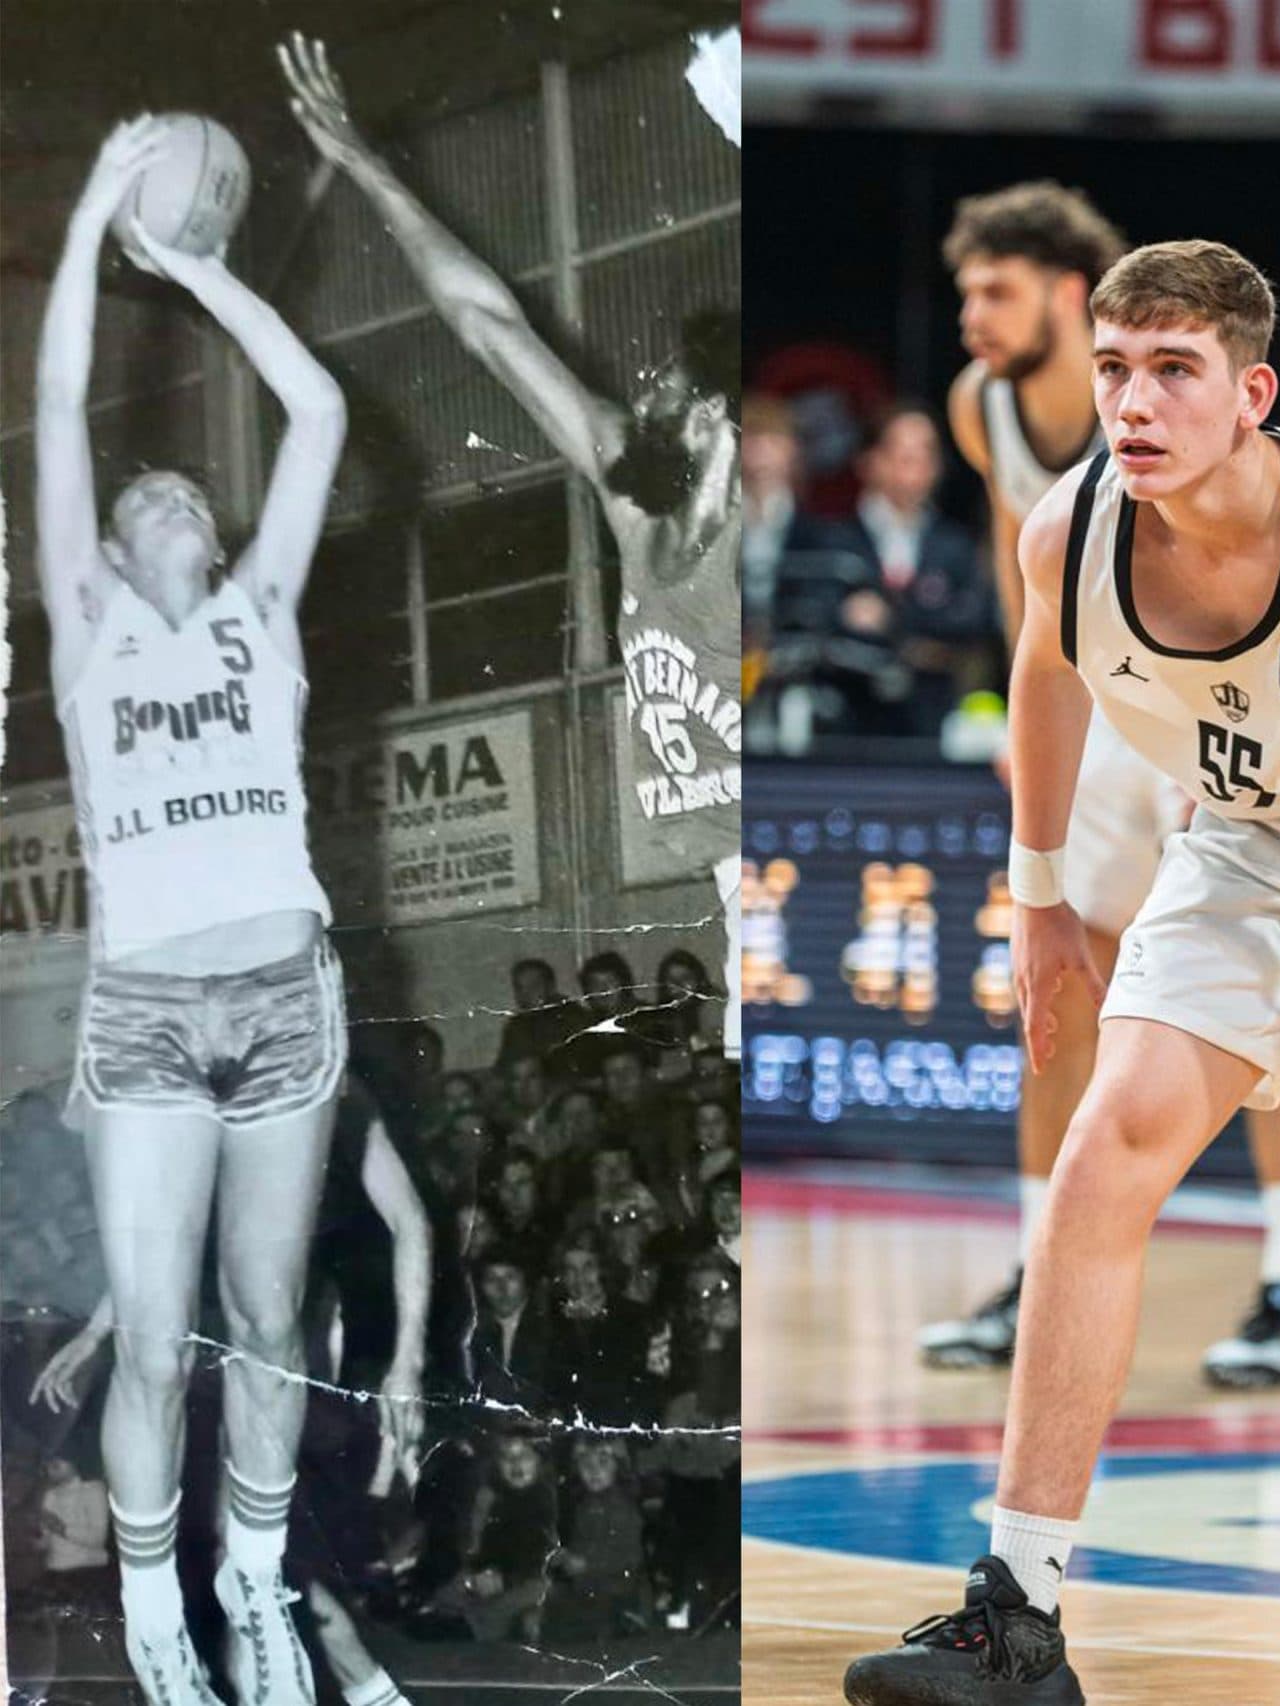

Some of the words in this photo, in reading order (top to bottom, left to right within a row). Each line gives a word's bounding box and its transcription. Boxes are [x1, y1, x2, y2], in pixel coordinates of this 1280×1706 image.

[209, 617, 253, 674] 5
[641, 702, 698, 774] 15
[1198, 719, 1276, 808] 55
[164, 788, 288, 827] BOURG
